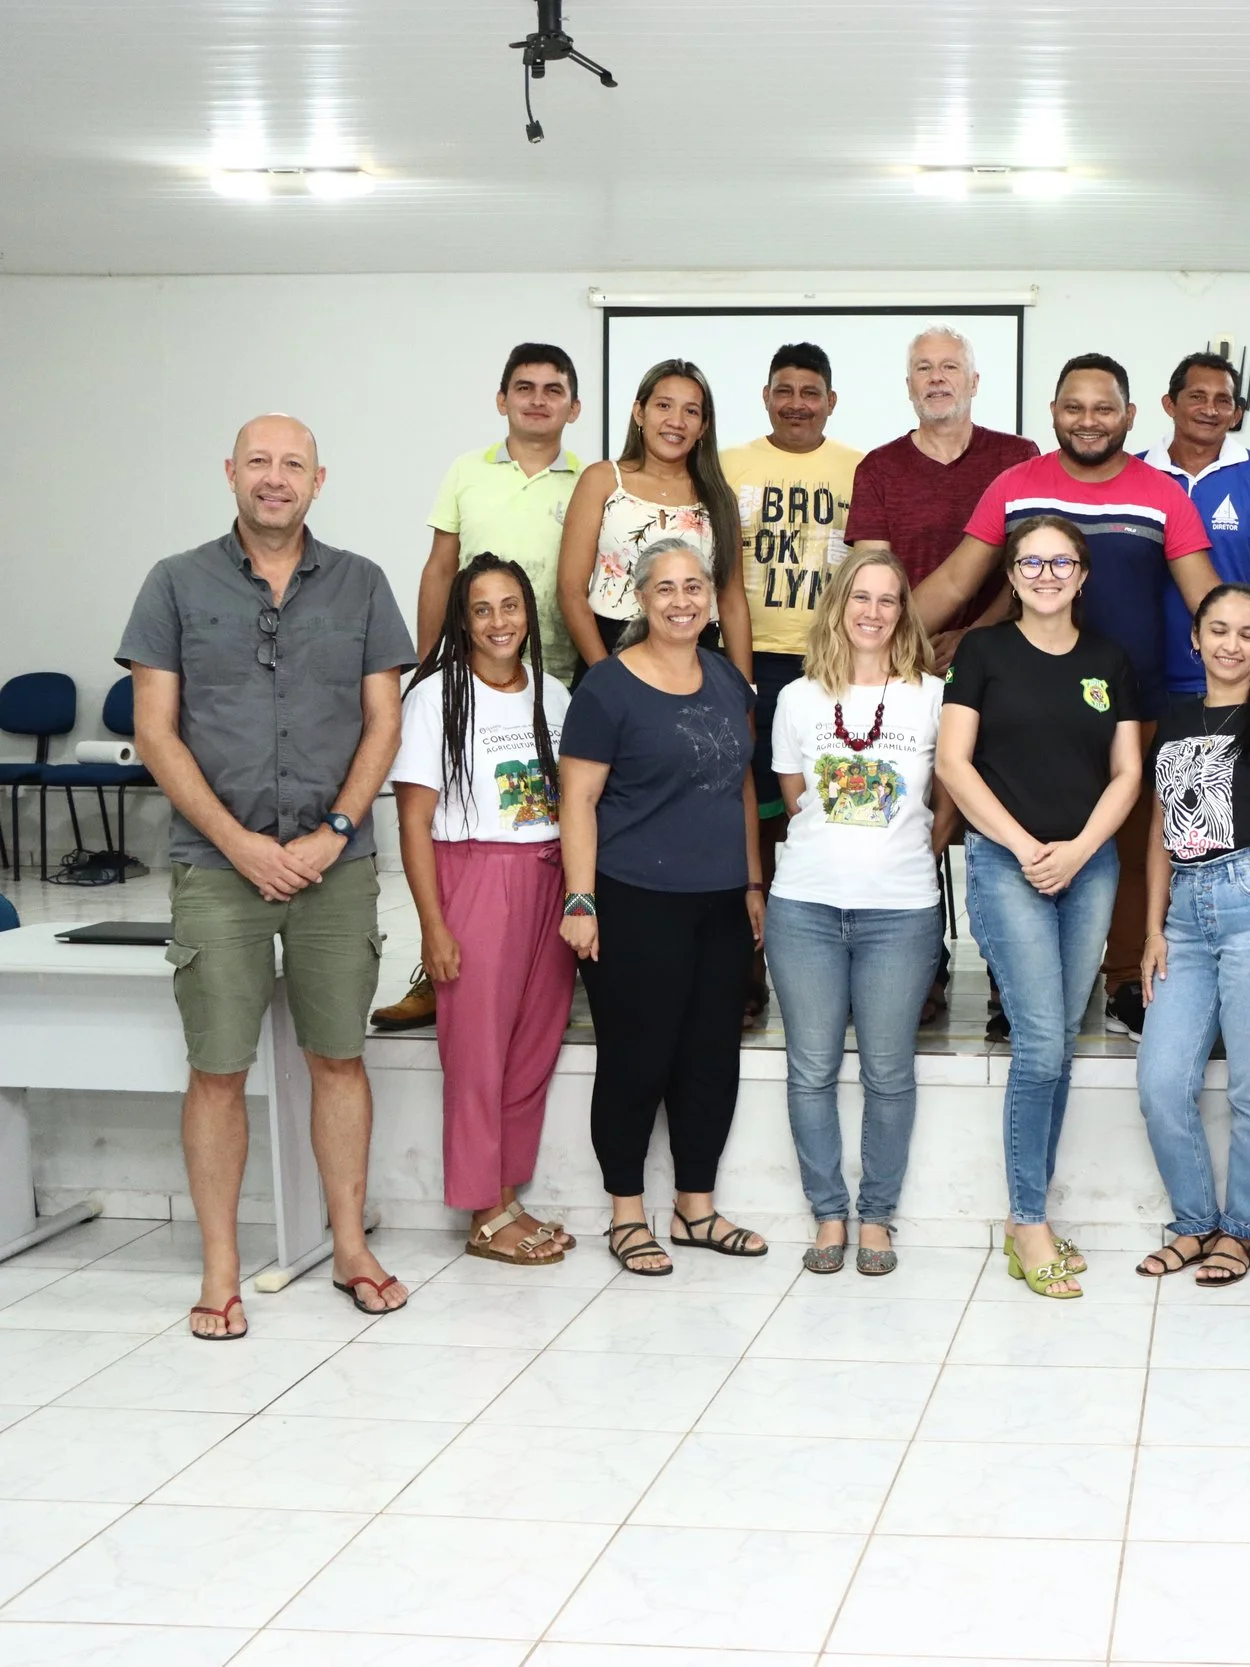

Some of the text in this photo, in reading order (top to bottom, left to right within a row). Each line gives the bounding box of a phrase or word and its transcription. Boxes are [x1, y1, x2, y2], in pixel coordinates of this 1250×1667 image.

[1212, 523, 1239, 531] DIRETOR
[909, 735, 916, 743] A
[486, 741, 536, 754] AGRICULTUR
[878, 743, 917, 752] FAMILIAR
